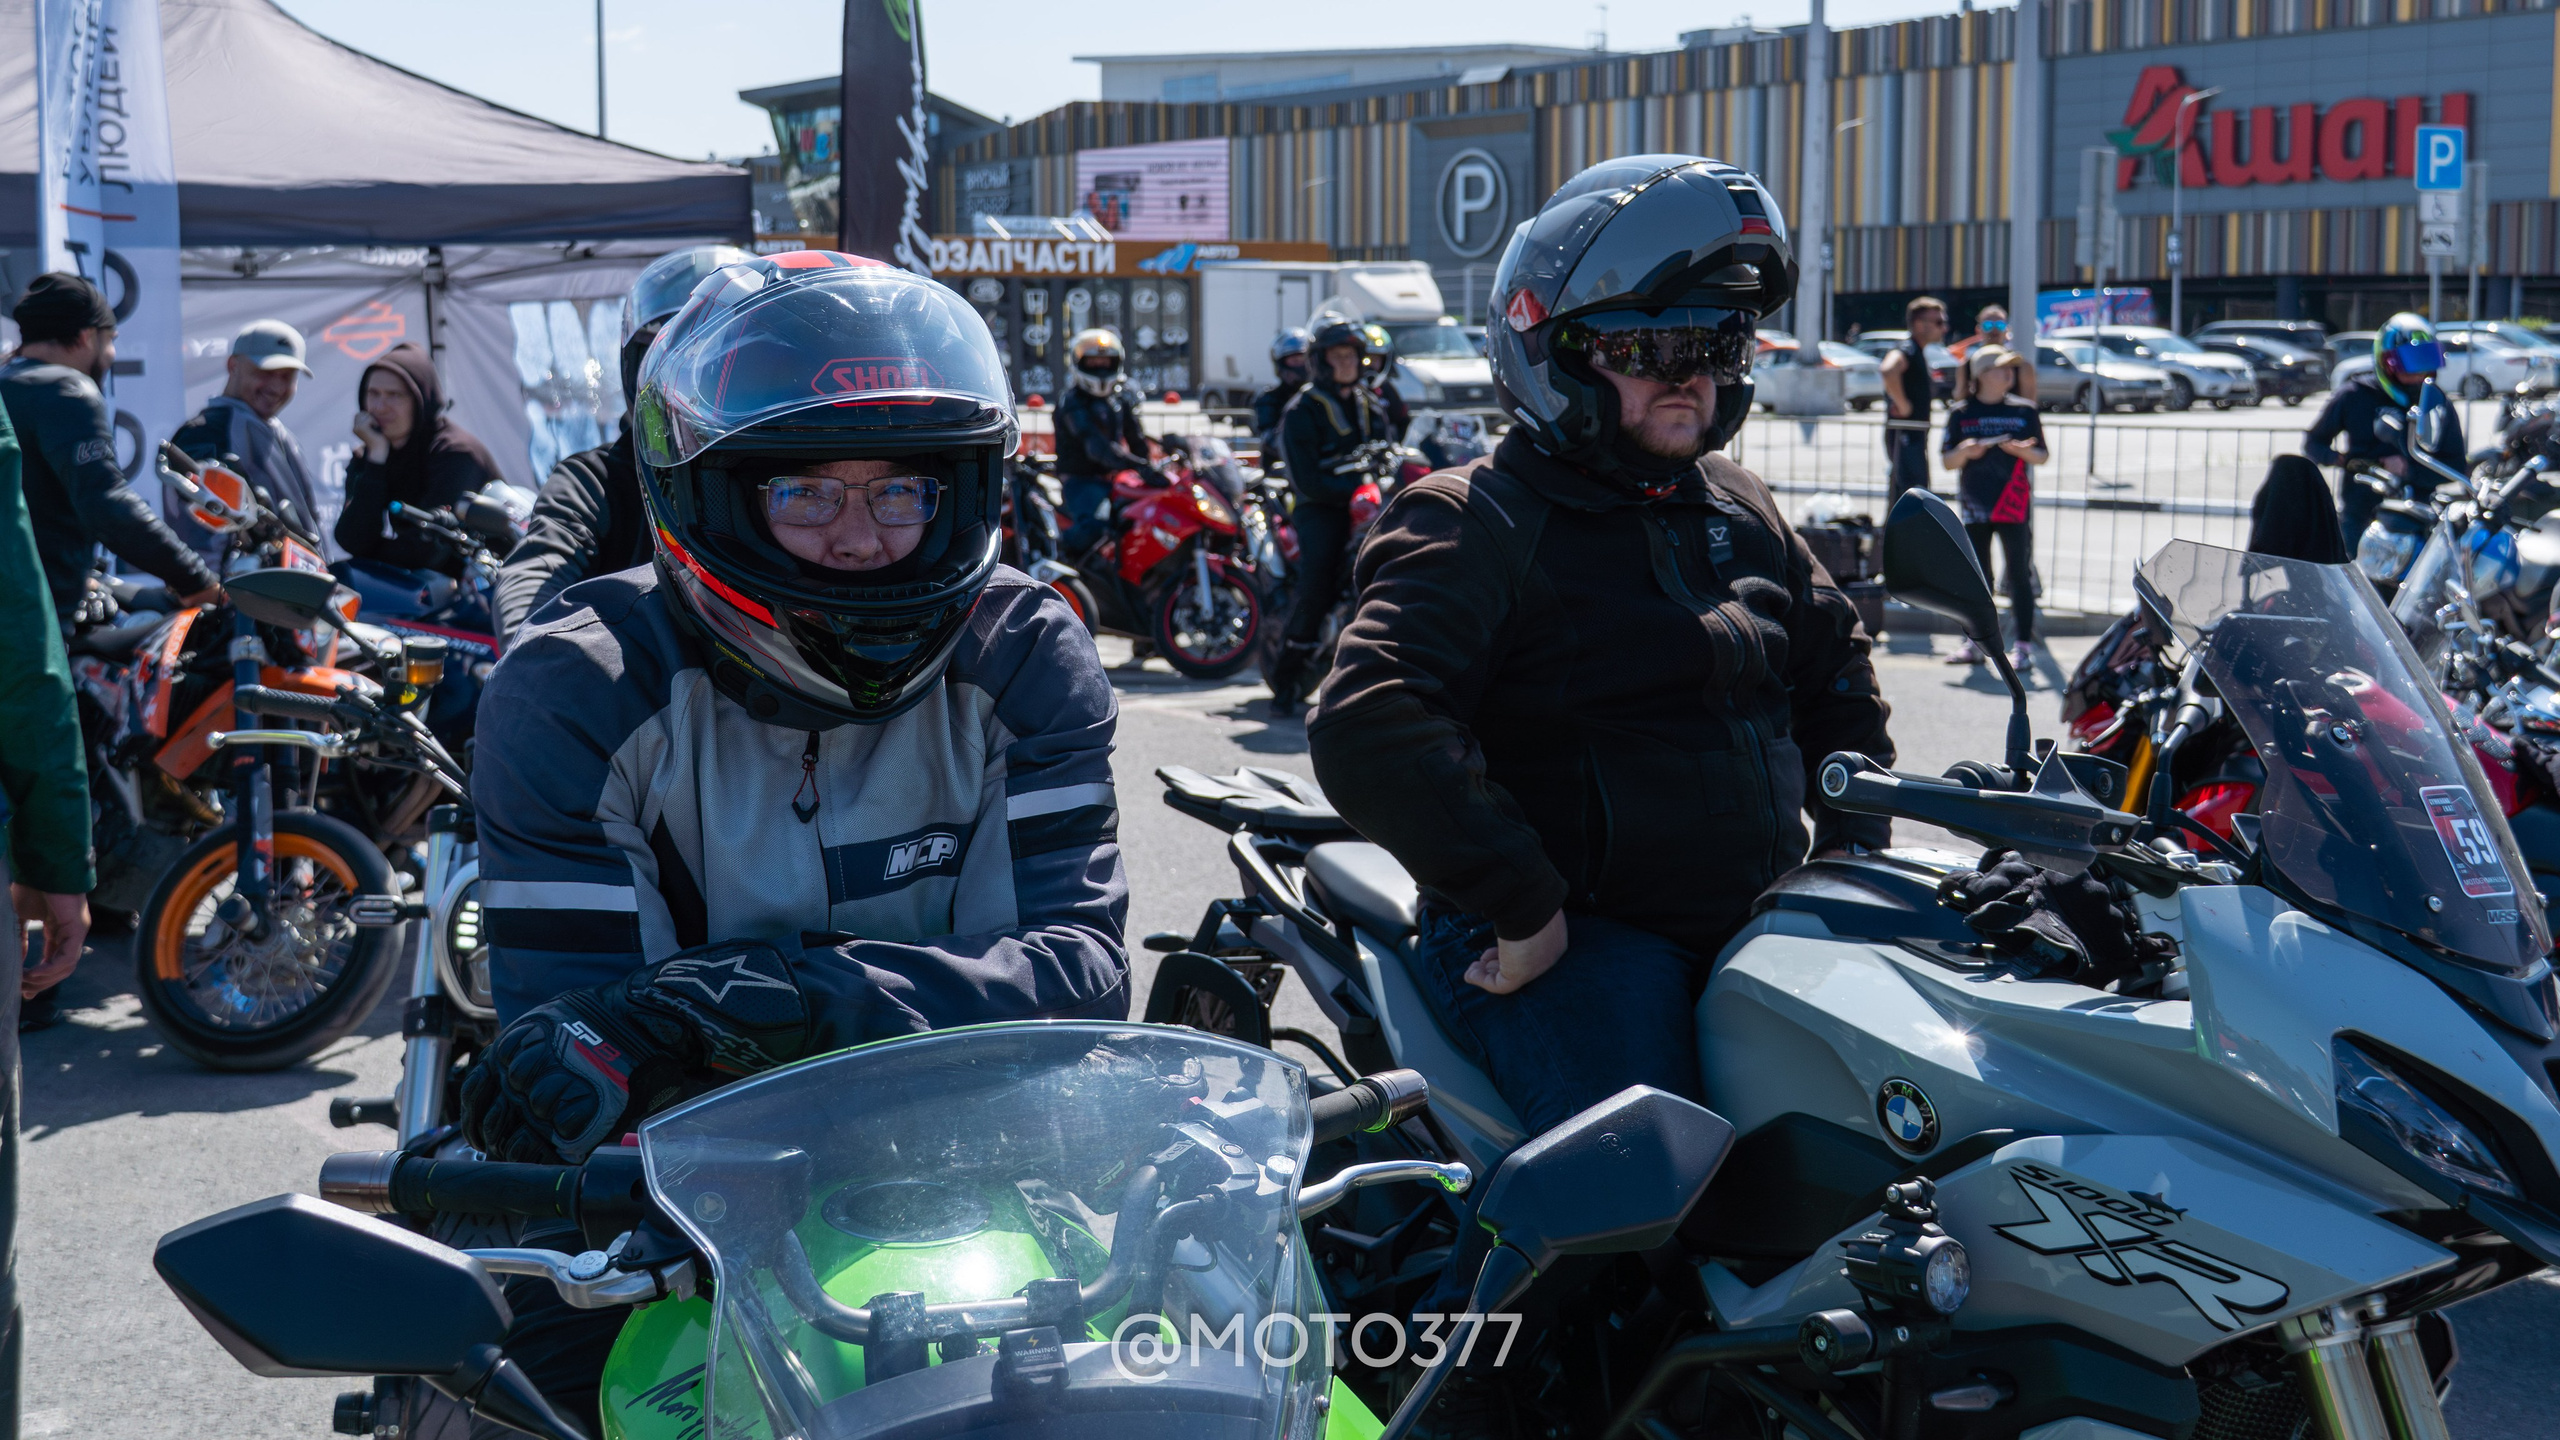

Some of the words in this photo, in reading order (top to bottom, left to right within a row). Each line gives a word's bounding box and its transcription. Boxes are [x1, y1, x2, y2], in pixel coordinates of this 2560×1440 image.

[2429, 134, 2456, 183] P
[1454, 163, 1496, 243] P
[931, 238, 1117, 274] ОЗАПЧАСТИ
[832, 365, 930, 394] SHOEI
[886, 835, 957, 877] MCP
[2449, 818, 2497, 865] 59
[2487, 909, 2518, 924] WRS
[1988, 1170, 2291, 1332] XR
[1014, 1345, 1058, 1357] WARNING
